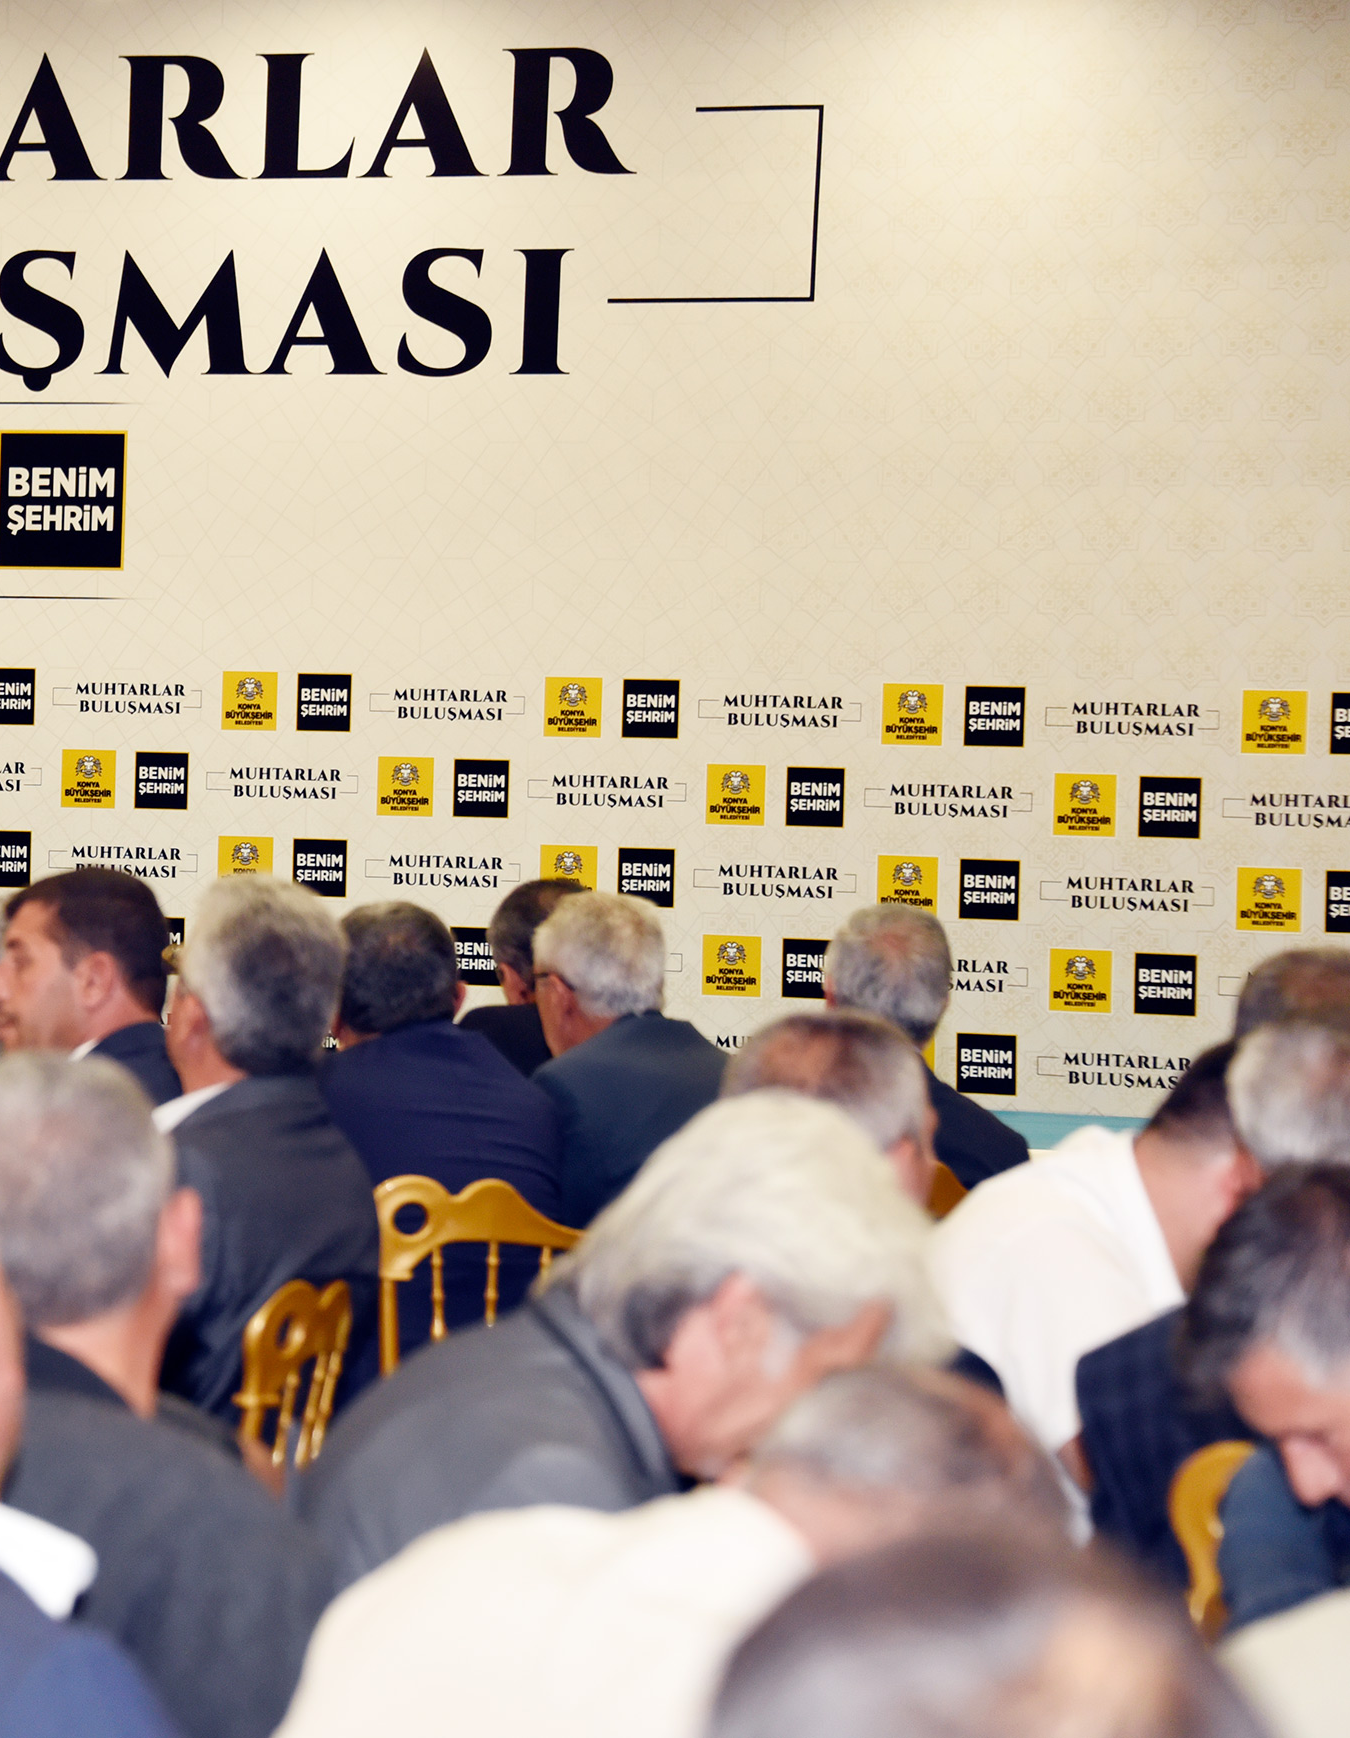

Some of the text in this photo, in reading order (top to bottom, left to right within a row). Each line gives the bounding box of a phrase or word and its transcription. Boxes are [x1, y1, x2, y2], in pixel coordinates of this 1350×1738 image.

[75, 683, 186, 696] MUHTARLAR
[393, 689, 509, 702] MUHTARLAR
[79, 700, 180, 714] BULUŞMASI
[722, 695, 844, 709] MUHTARLAR
[397, 707, 502, 721] BULUŞMASI
[1071, 703, 1201, 717] MUHTARLAR
[727, 713, 838, 728] BULUŞMASI
[1076, 721, 1194, 736] BULUŞMASI
[229, 768, 342, 781] MUHTARLAR
[551, 775, 670, 789] MUHTARLAR
[233, 785, 336, 799] BULUŞMASI
[889, 784, 1014, 799] MUHTARLAR
[556, 793, 663, 807] BULUŞMASI
[894, 802, 1008, 817] BULUŞMASI
[71, 845, 182, 860] MUHTARLAR
[388, 855, 504, 869] MUHTARLAR
[717, 865, 839, 880] MUHTARLAR
[393, 873, 498, 887] BULUŞMASI
[1065, 877, 1195, 893] MUHTARLAR
[723, 883, 833, 898] BULUŞMASI
[1071, 896, 1188, 912] BULUŞMASI
[1063, 1053, 1192, 1072] MUHTARLAR
[1068, 1071, 1181, 1090] BULUŞMAS
